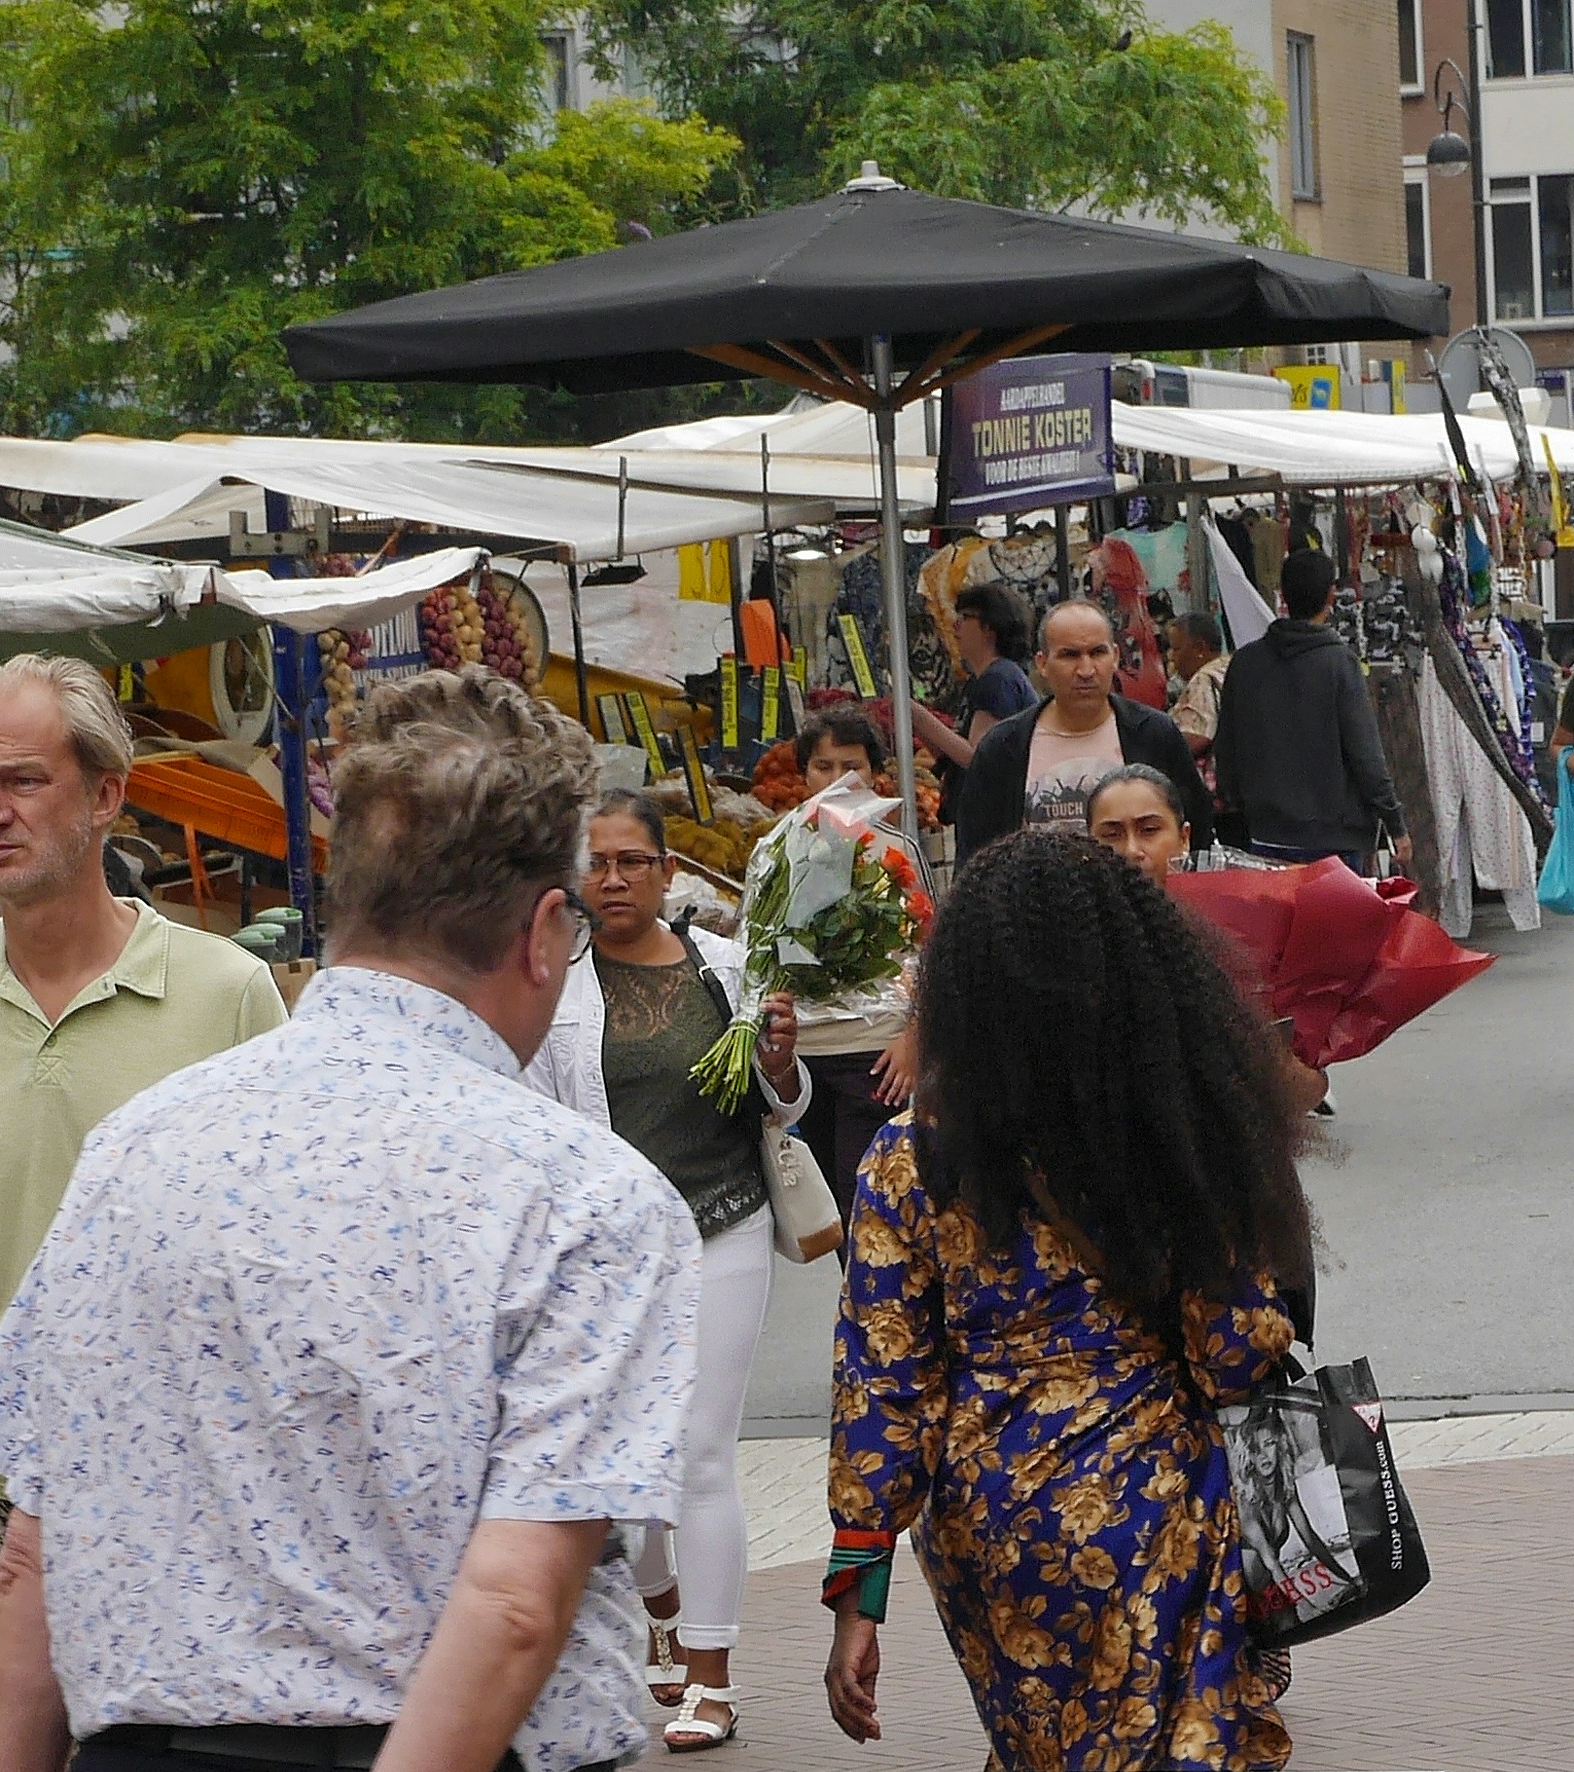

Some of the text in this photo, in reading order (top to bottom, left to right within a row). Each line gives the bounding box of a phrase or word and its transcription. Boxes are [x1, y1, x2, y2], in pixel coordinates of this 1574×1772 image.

[972, 408, 1092, 457] TONNIE KOSTER
[1044, 801, 1084, 818] TOUCH
[1389, 1528, 1403, 1571] SHOP
